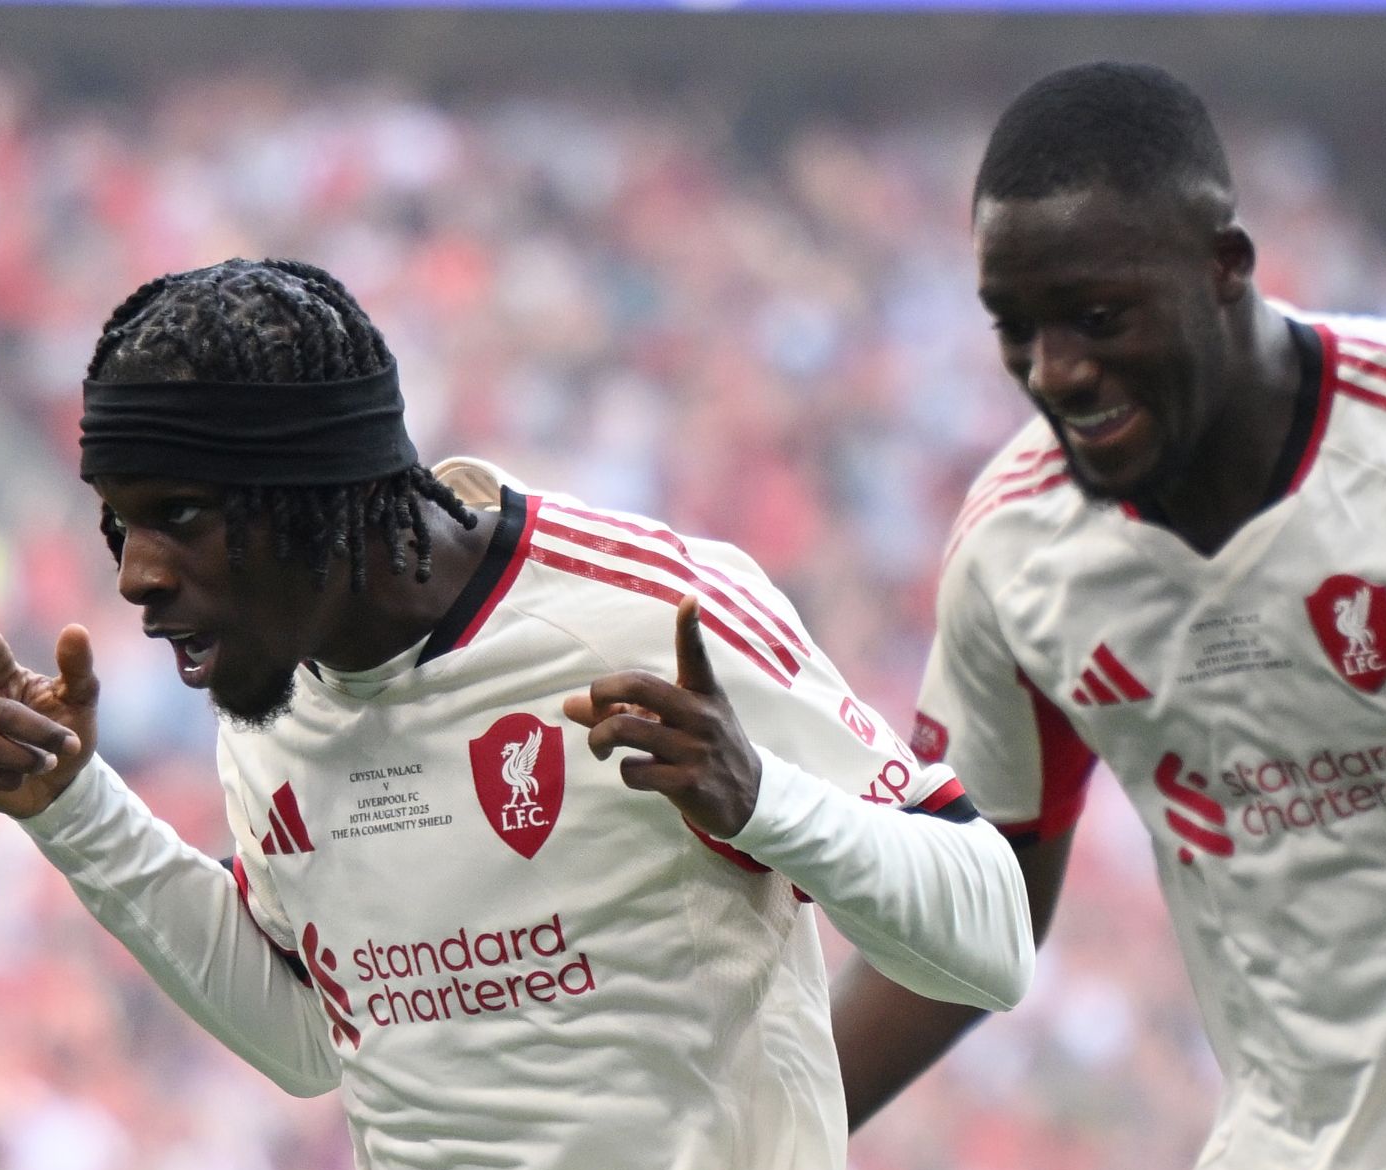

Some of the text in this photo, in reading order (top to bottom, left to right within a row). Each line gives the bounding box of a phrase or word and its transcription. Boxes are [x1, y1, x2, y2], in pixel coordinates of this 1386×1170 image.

[349, 763, 423, 783] CRYSTAL PALACE
[382, 781, 390, 791] V
[357, 791, 420, 809] LIVERPOOL FC
[349, 804, 430, 824] 10TH AUGUST 2025
[331, 814, 453, 840] THE FA COMMUNITY SHIELD
[352, 912, 568, 983] standard
[366, 952, 596, 1027] chartered
